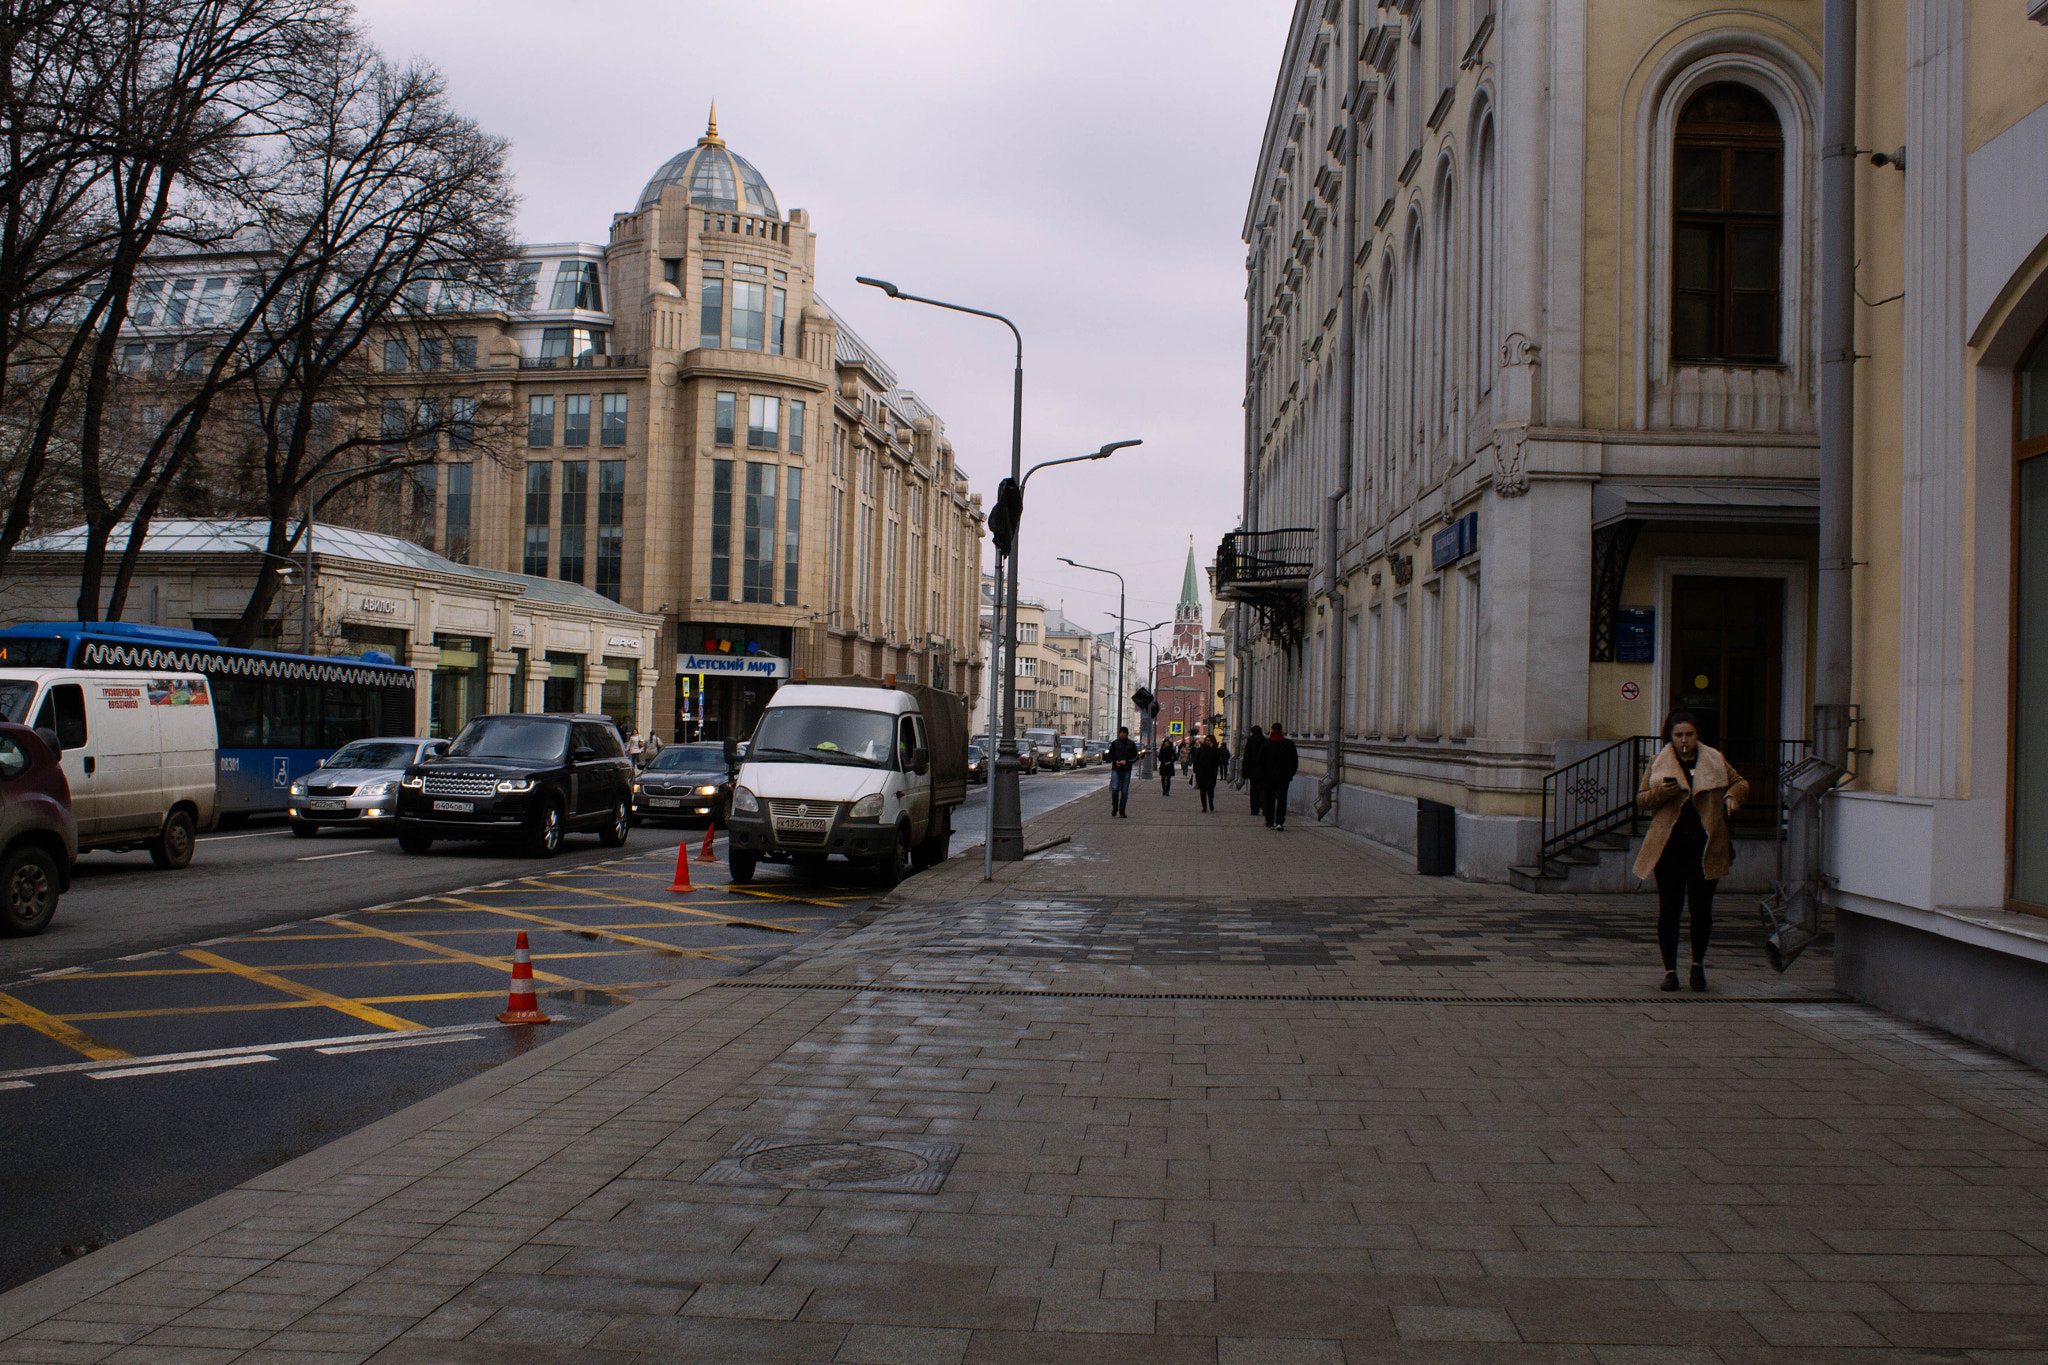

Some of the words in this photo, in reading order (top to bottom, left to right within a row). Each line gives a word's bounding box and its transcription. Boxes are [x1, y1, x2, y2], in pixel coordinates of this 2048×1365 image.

[363, 598, 396, 613] АВИЛОН
[685, 655, 744, 671] Детский
[747, 661, 776, 676] мир
